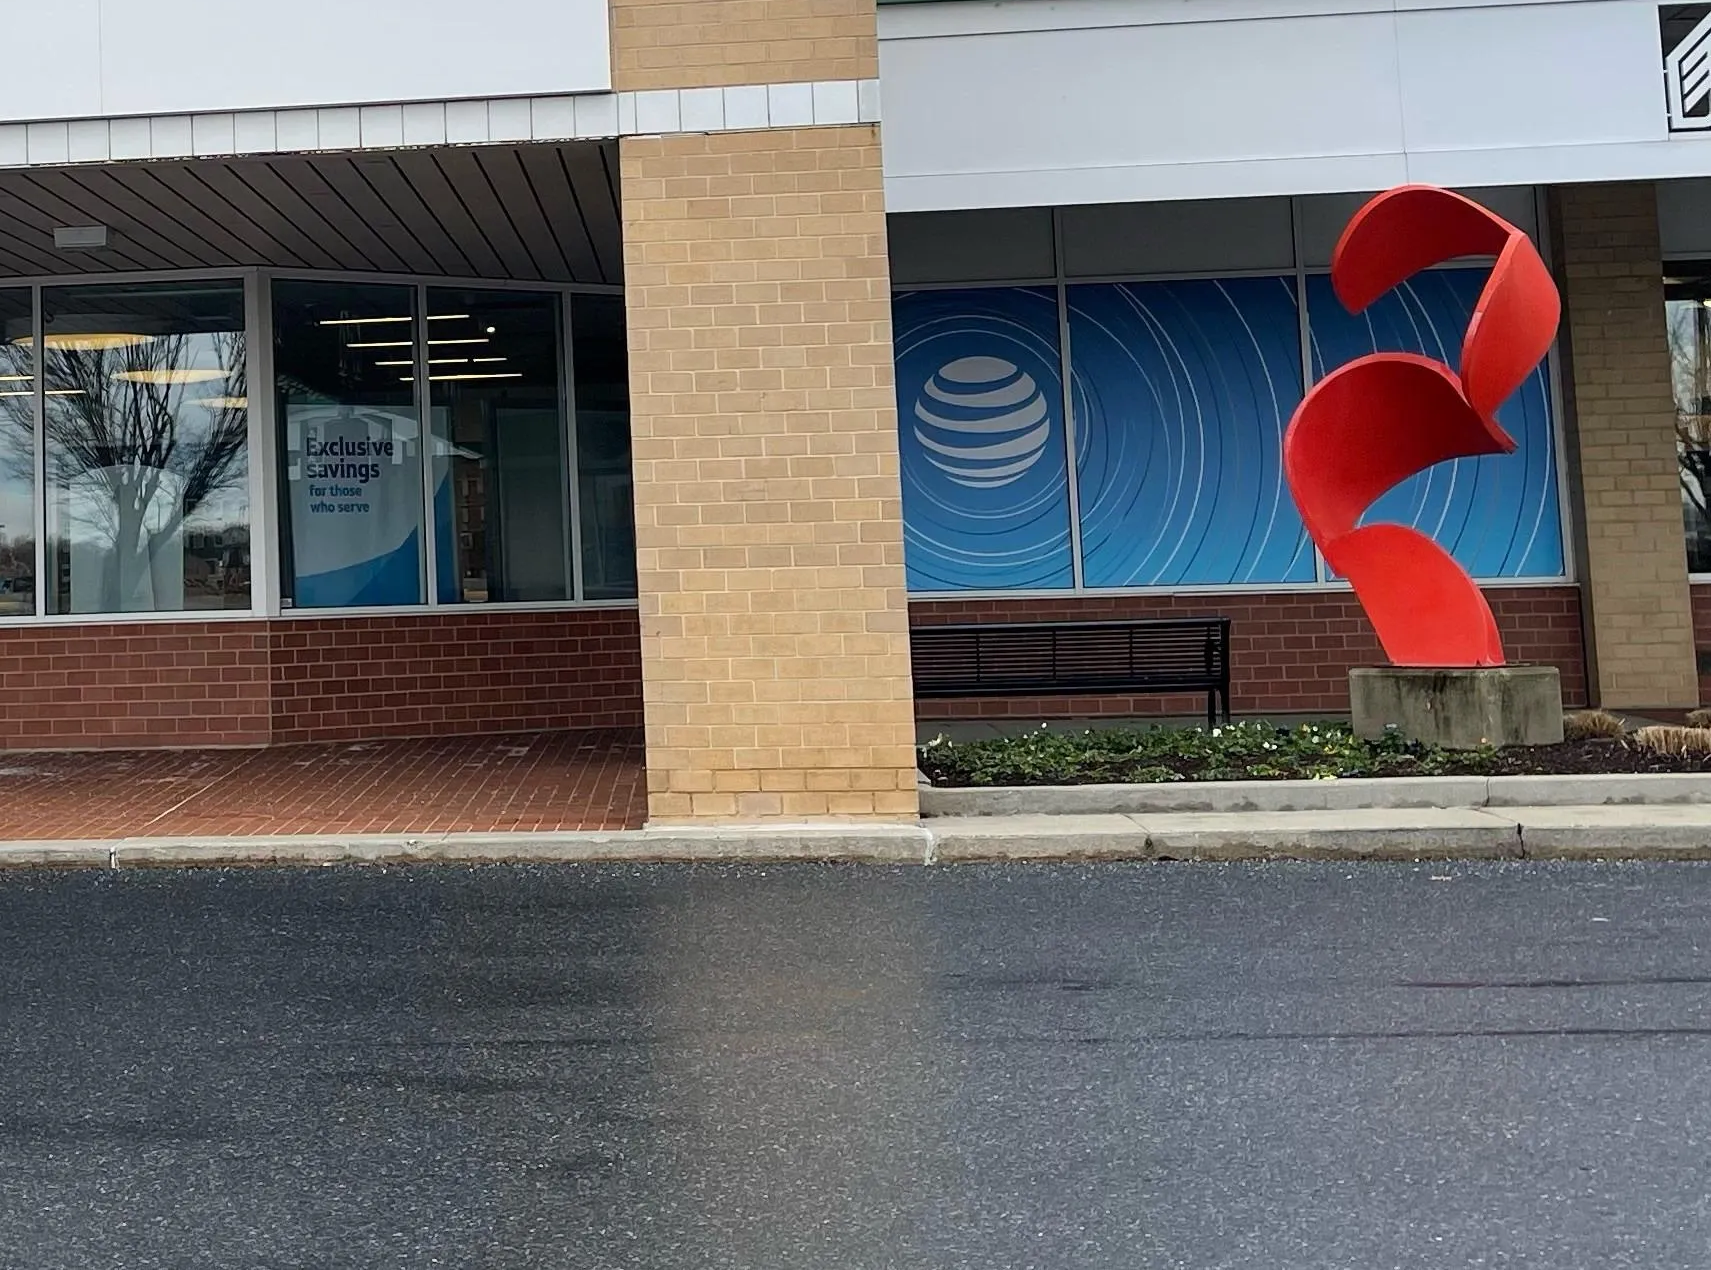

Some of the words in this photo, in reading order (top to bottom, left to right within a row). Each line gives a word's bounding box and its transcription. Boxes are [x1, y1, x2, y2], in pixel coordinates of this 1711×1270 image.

[306, 435, 393, 457] Exclusive
[307, 458, 380, 483] savings
[309, 484, 328, 496] for
[330, 484, 362, 496] those
[310, 500, 335, 512] who
[337, 503, 370, 512] serve
